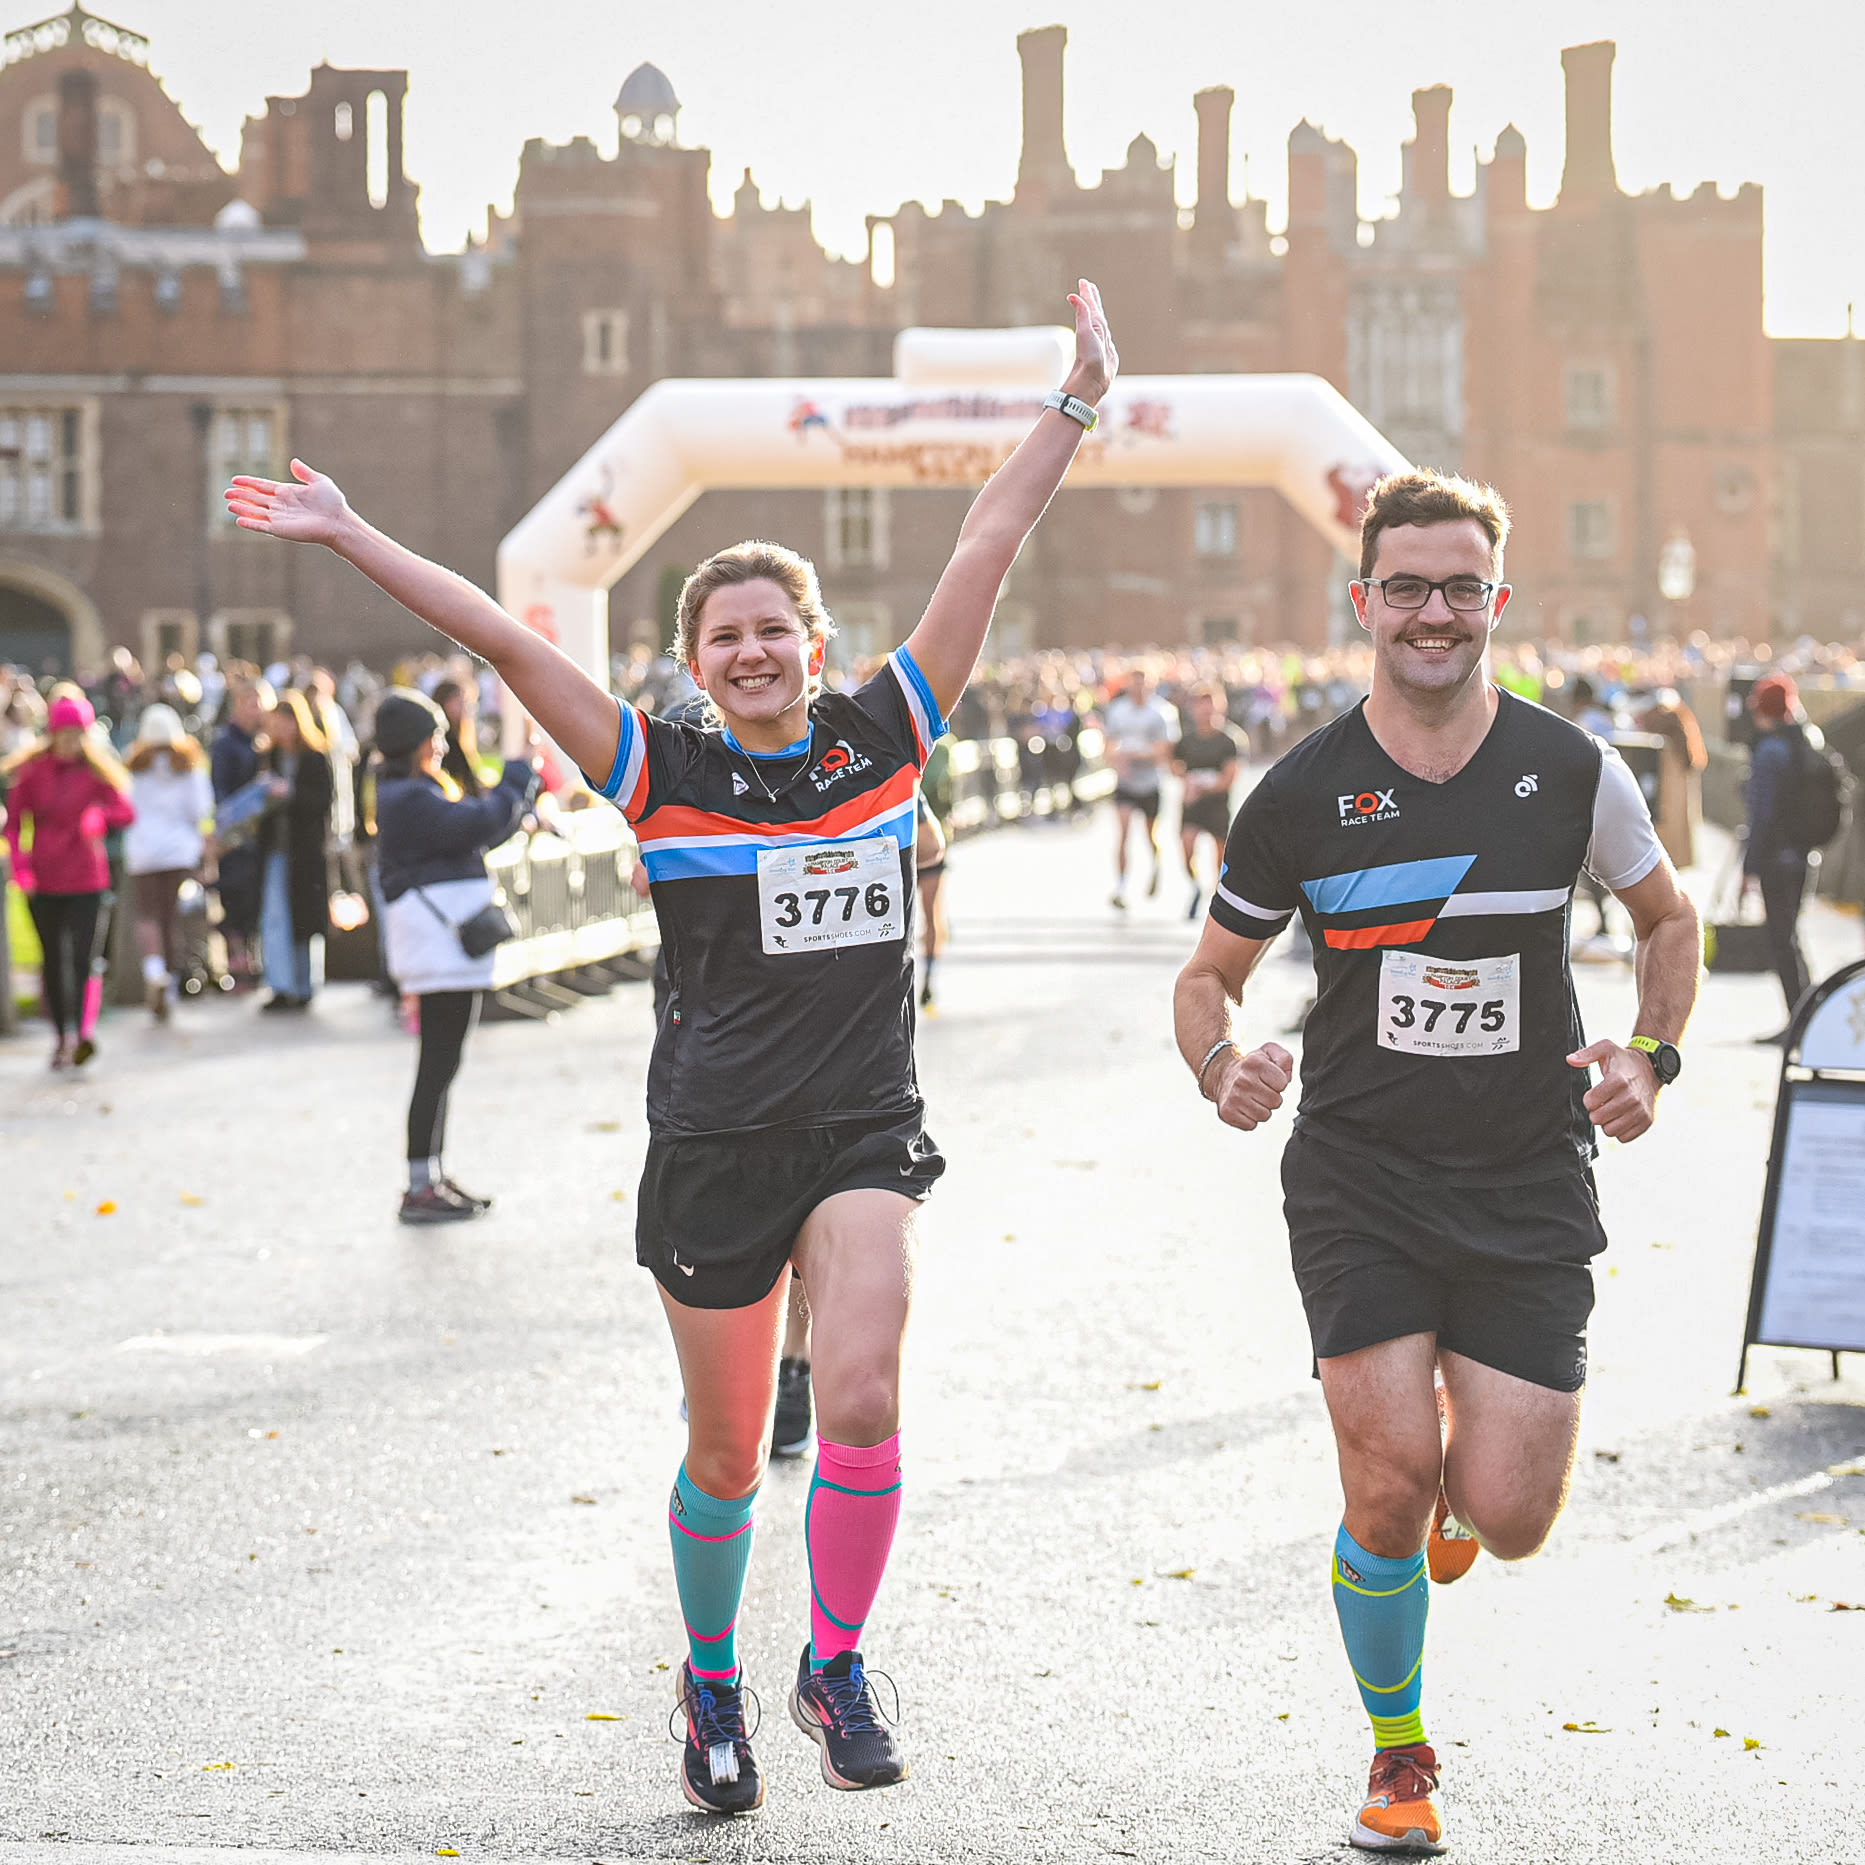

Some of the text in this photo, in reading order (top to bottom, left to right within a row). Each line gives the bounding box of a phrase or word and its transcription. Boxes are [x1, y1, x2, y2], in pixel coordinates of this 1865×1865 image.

[815, 768, 845, 793] RACE
[1337, 788, 1398, 817] FOX
[1340, 810, 1400, 828] RACE TEAM
[773, 882, 890, 928] 3776
[1390, 995, 1506, 1034] 3775
